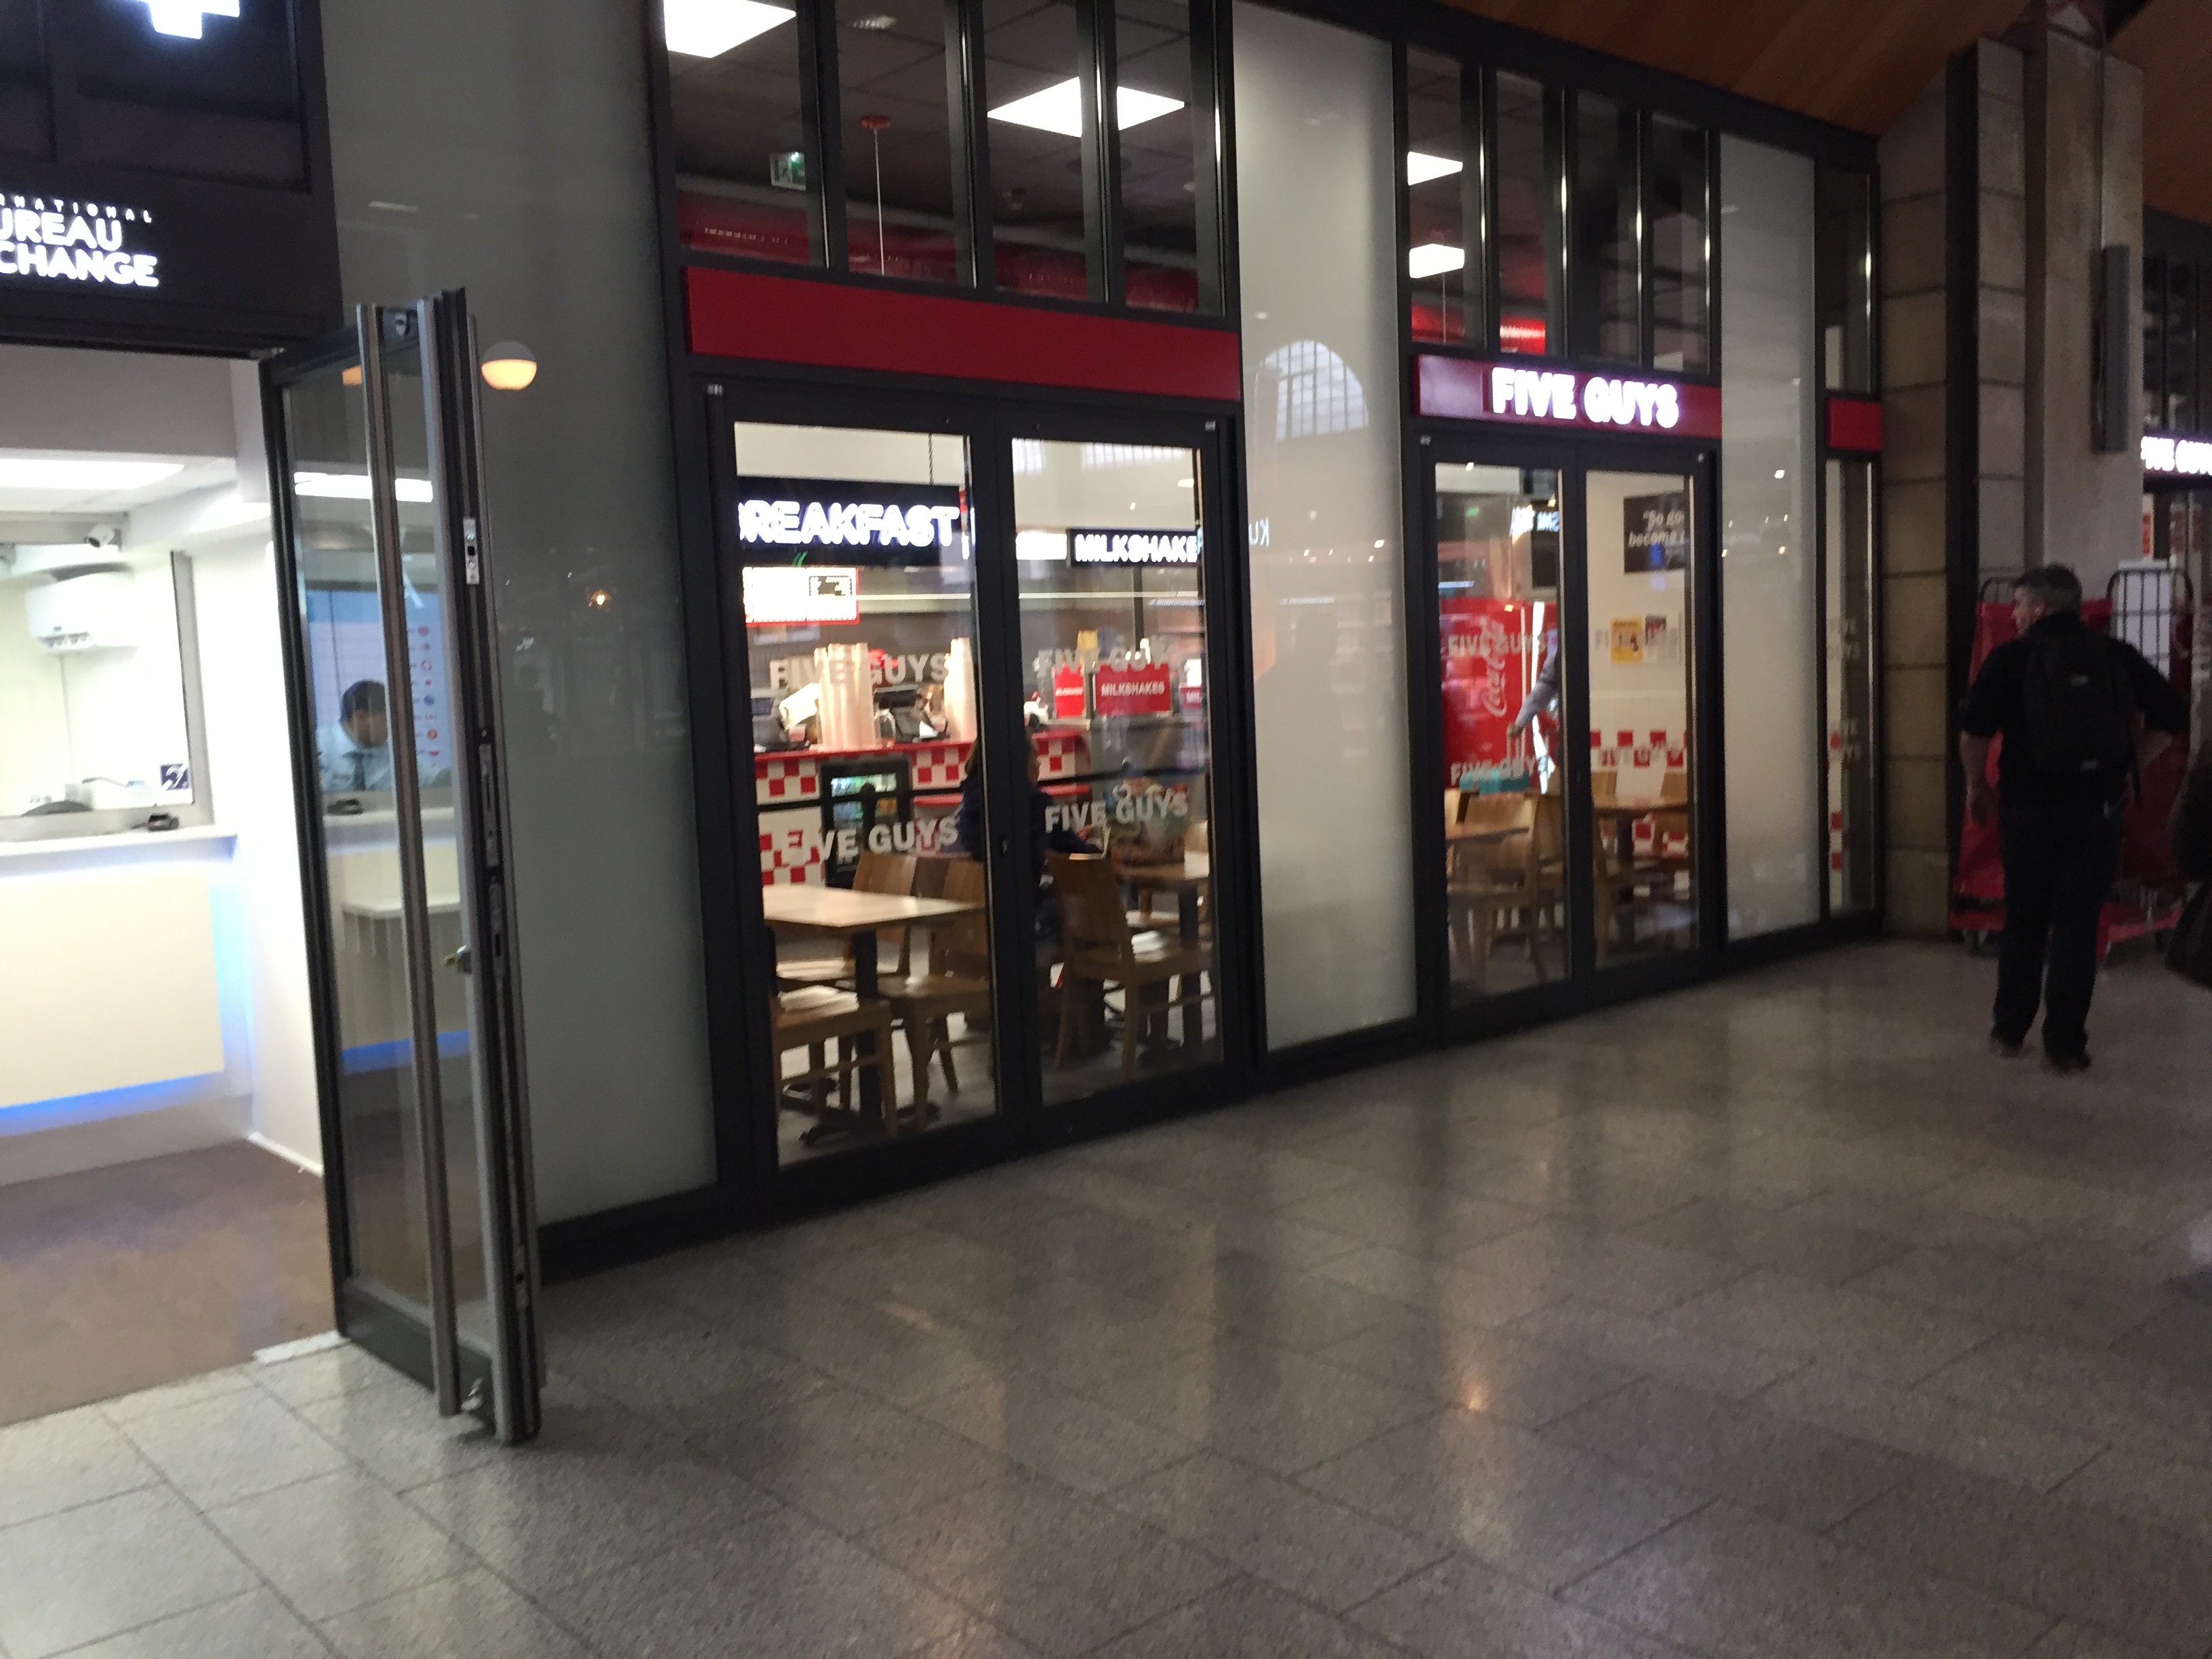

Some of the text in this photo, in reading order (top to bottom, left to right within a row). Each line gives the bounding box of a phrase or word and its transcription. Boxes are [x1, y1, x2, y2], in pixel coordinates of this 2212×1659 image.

[0, 192, 152, 223] NATIONAL
[1492, 367, 1679, 428] FIVE GUYS
[738, 499, 960, 547] REAKFAST
[1101, 680, 1166, 698] MILKSHAKES
[1045, 787, 1189, 834] FIVE GUYS
[868, 817, 958, 856] GUYS
